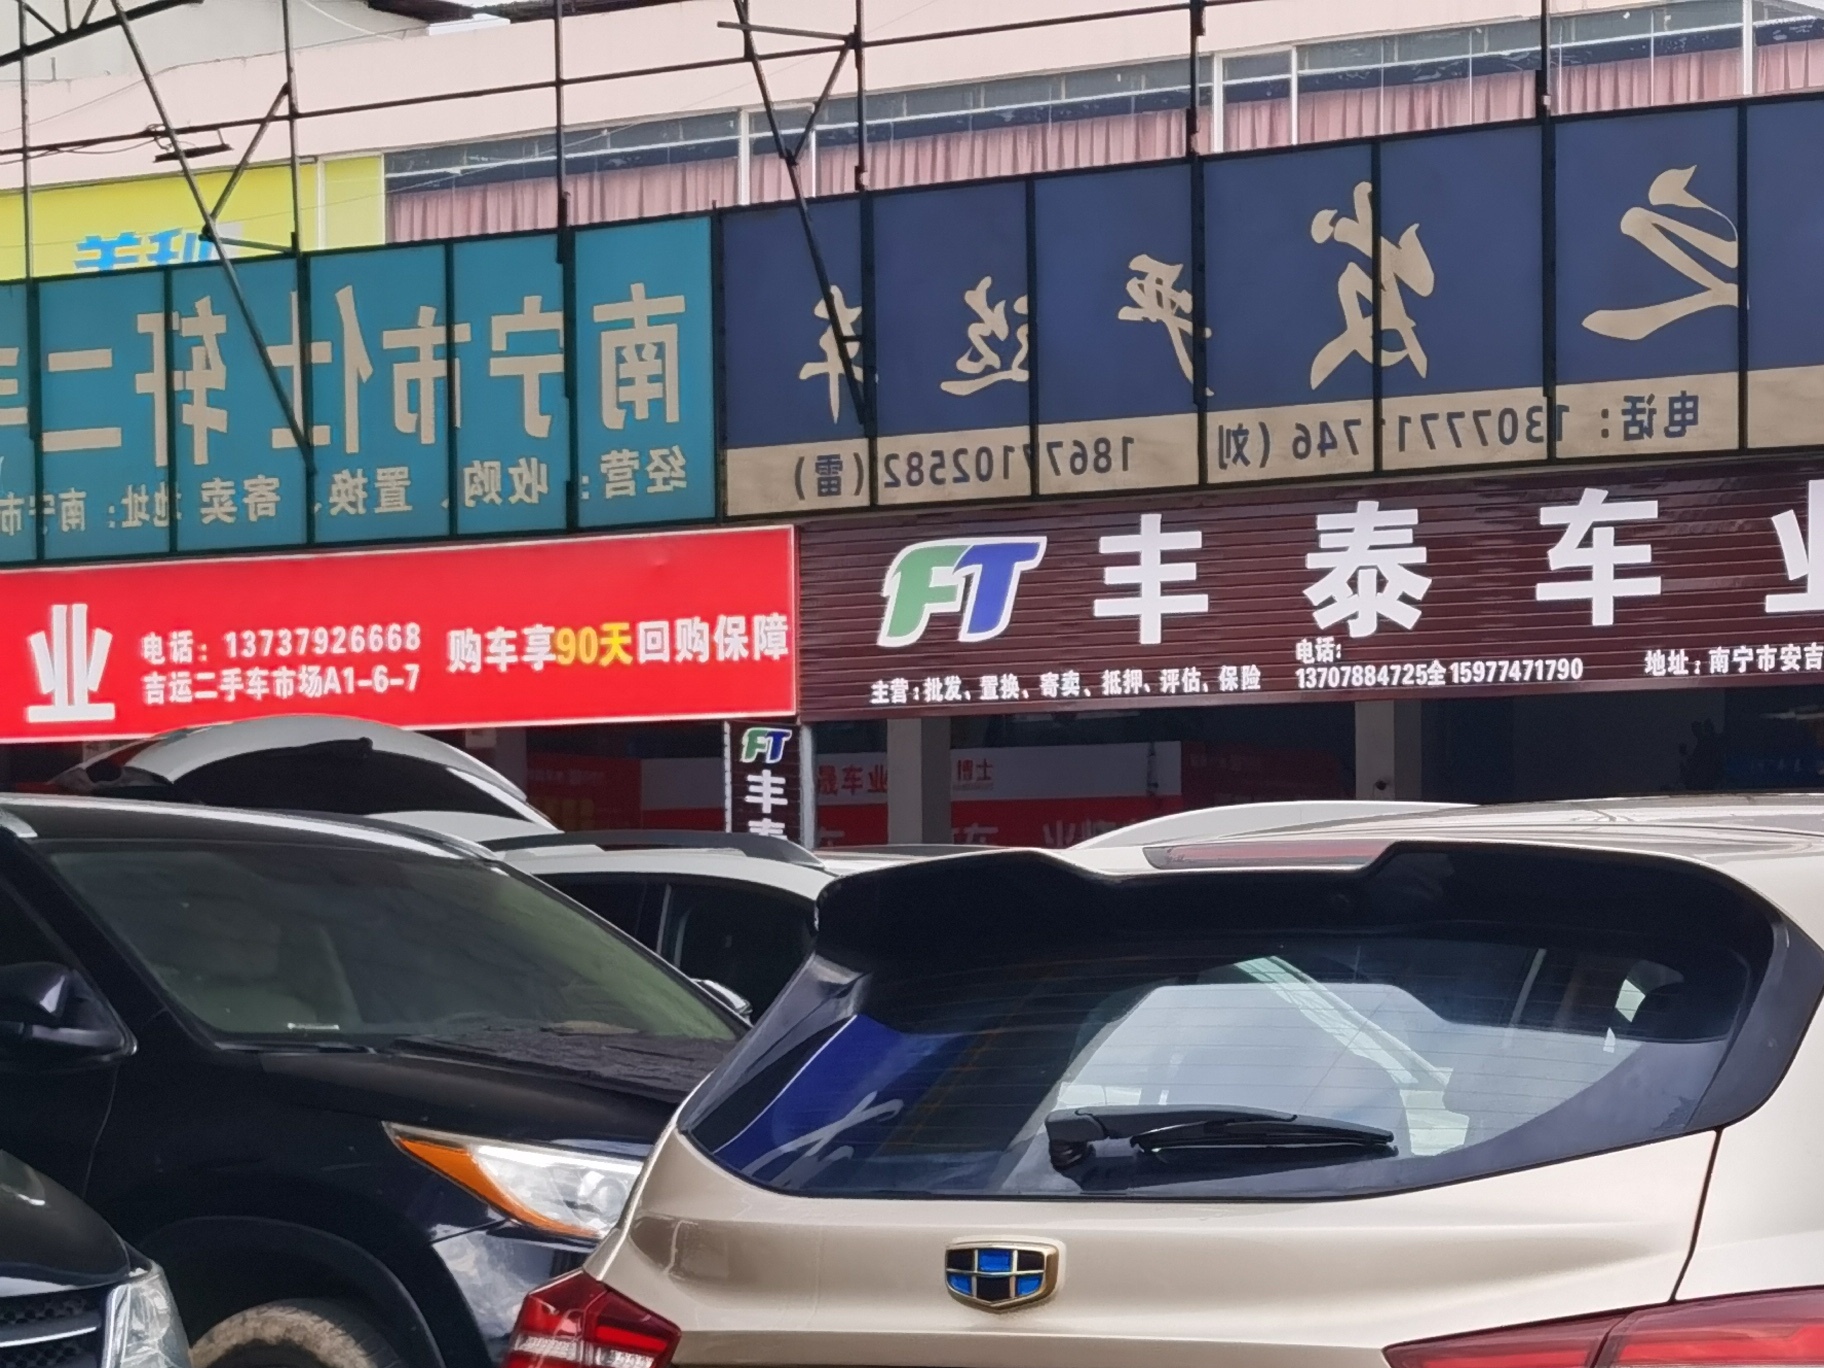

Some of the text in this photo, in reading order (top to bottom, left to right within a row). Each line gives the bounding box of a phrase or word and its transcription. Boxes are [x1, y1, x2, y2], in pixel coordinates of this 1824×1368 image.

[876, 536, 1048, 647] FT
[26, 602, 117, 723] 业
[447, 612, 789, 674] 购车享90天回购保障
[142, 663, 420, 705] 吉运二手车市场A1-6-7
[740, 727, 793, 764] FT
